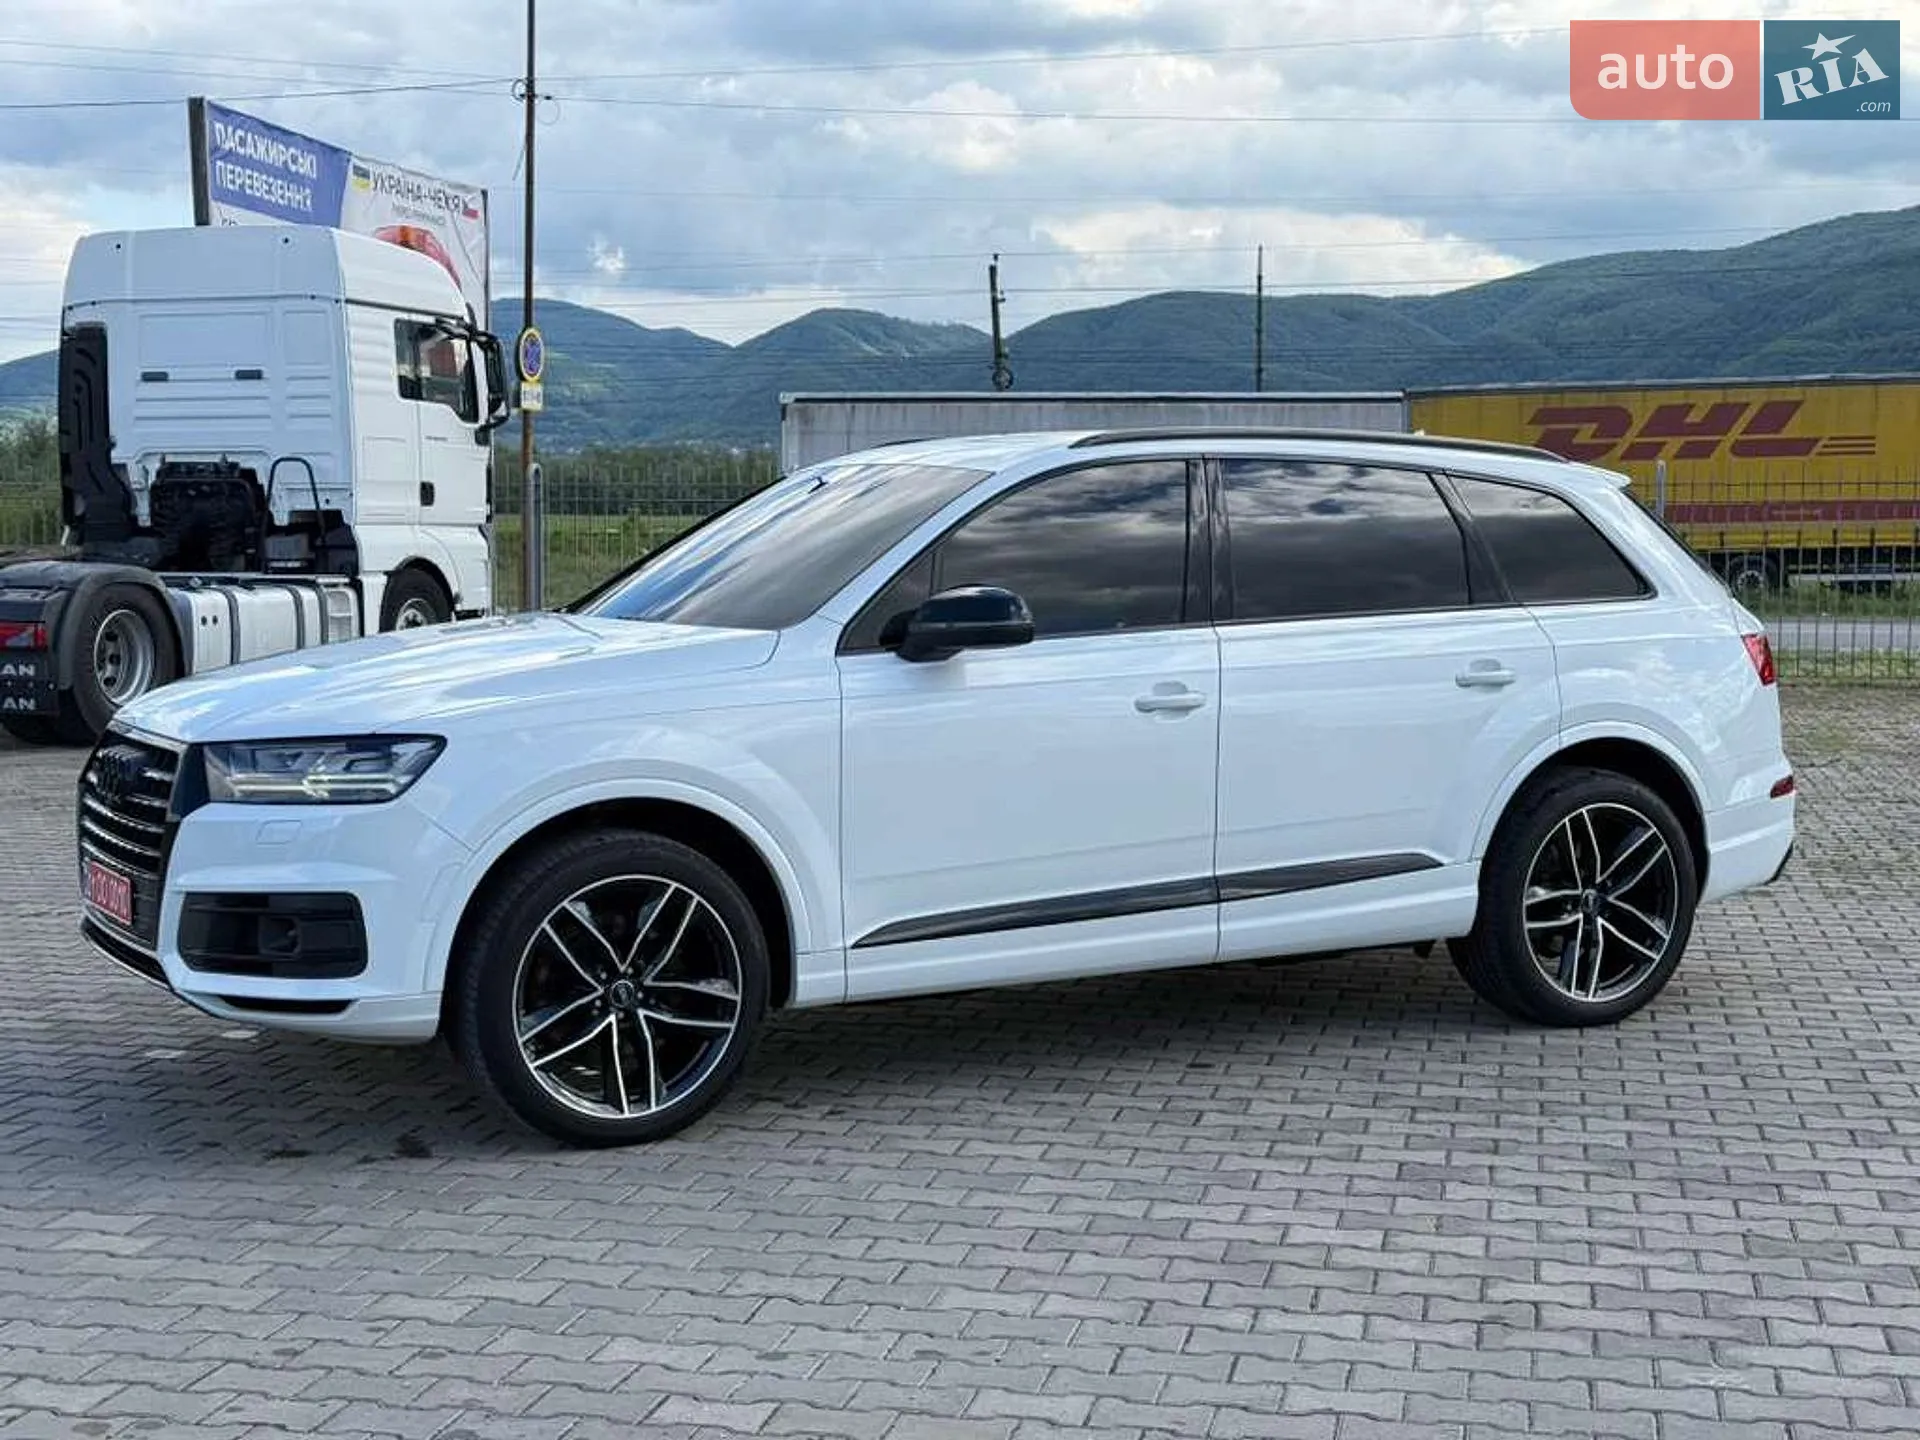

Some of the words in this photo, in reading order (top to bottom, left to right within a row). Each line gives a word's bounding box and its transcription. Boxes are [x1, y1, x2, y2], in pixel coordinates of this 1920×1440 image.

[214, 121, 317, 180] ПАСАЖИРСЬКІ
[215, 160, 313, 212] ПЕРЕВЕЗЕННЯ
[1528, 400, 1821, 462] DHL
